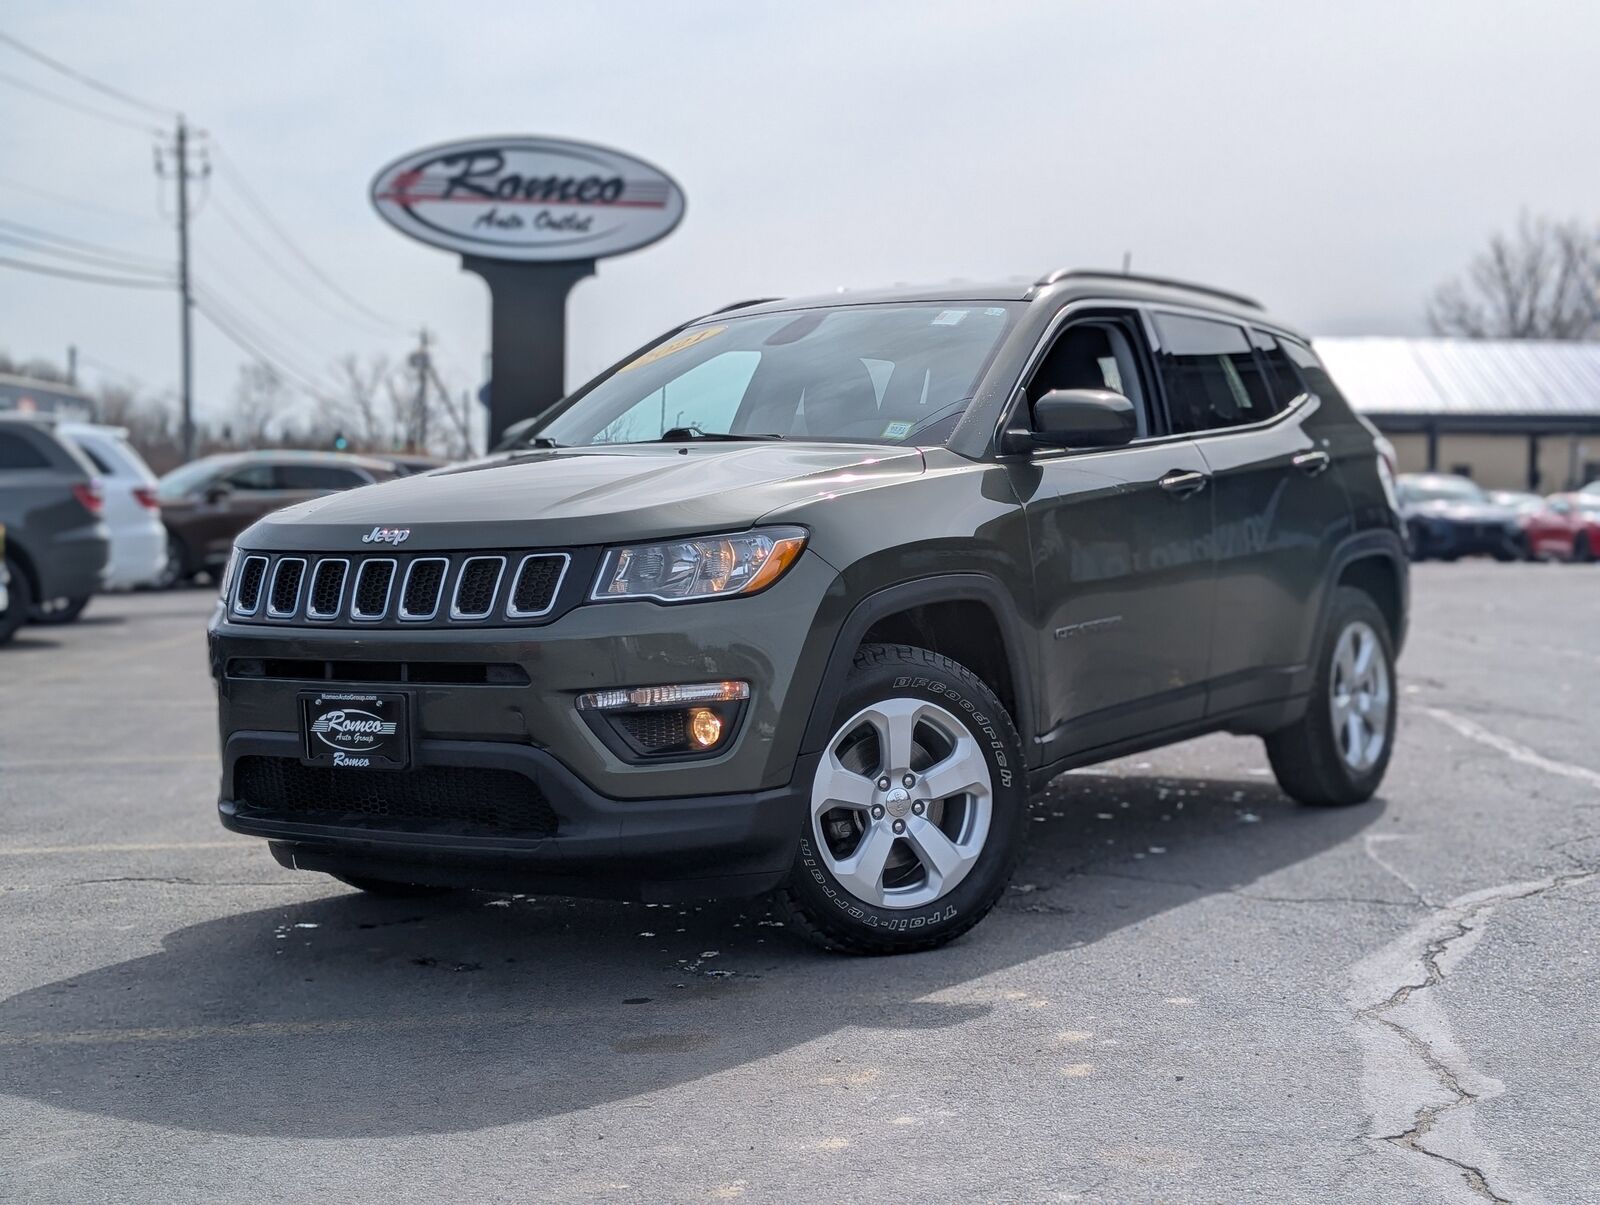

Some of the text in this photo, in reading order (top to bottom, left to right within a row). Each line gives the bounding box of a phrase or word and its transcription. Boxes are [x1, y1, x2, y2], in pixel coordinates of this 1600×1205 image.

[439, 147, 625, 201] Romeo
[472, 206, 525, 229] Auto
[362, 526, 411, 546] Jeep
[327, 711, 383, 732] Romeo
[893, 676, 1012, 788] BFGoodrich
[336, 733, 374, 744] Auto Group
[333, 752, 370, 767] Romeo
